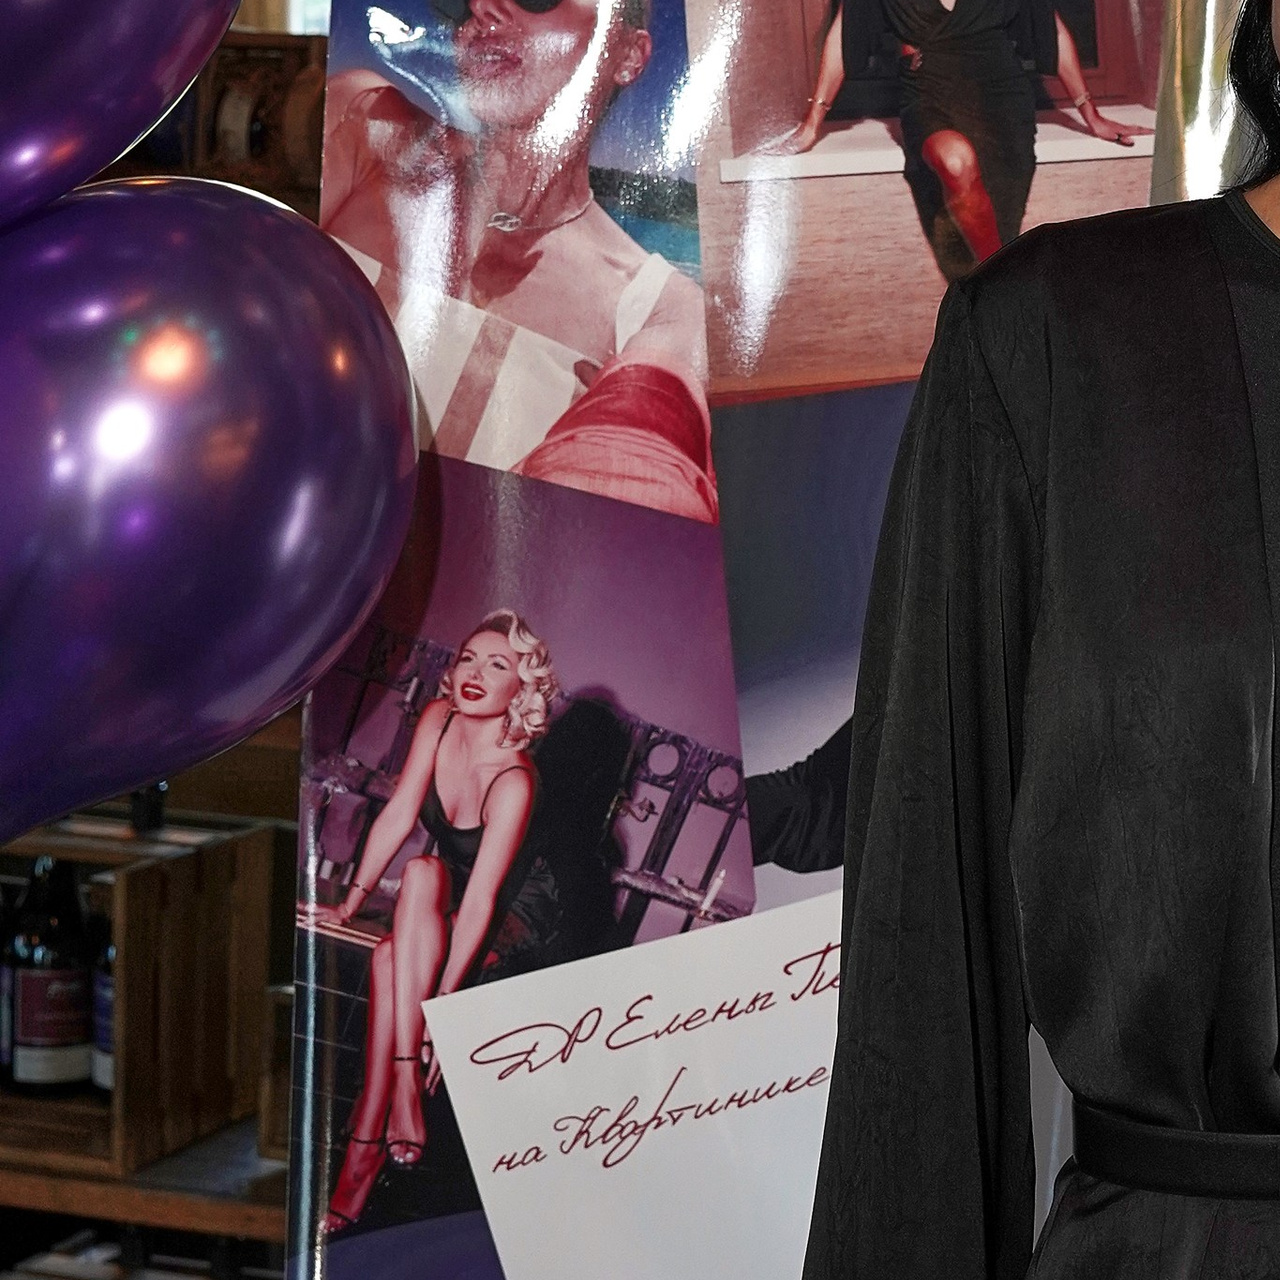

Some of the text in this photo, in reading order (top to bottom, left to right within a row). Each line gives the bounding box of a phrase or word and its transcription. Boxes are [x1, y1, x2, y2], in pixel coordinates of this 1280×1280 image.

[469, 1006, 603, 1081] ДР
[605, 992, 777, 1051] Елены
[491, 1145, 548, 1174] на
